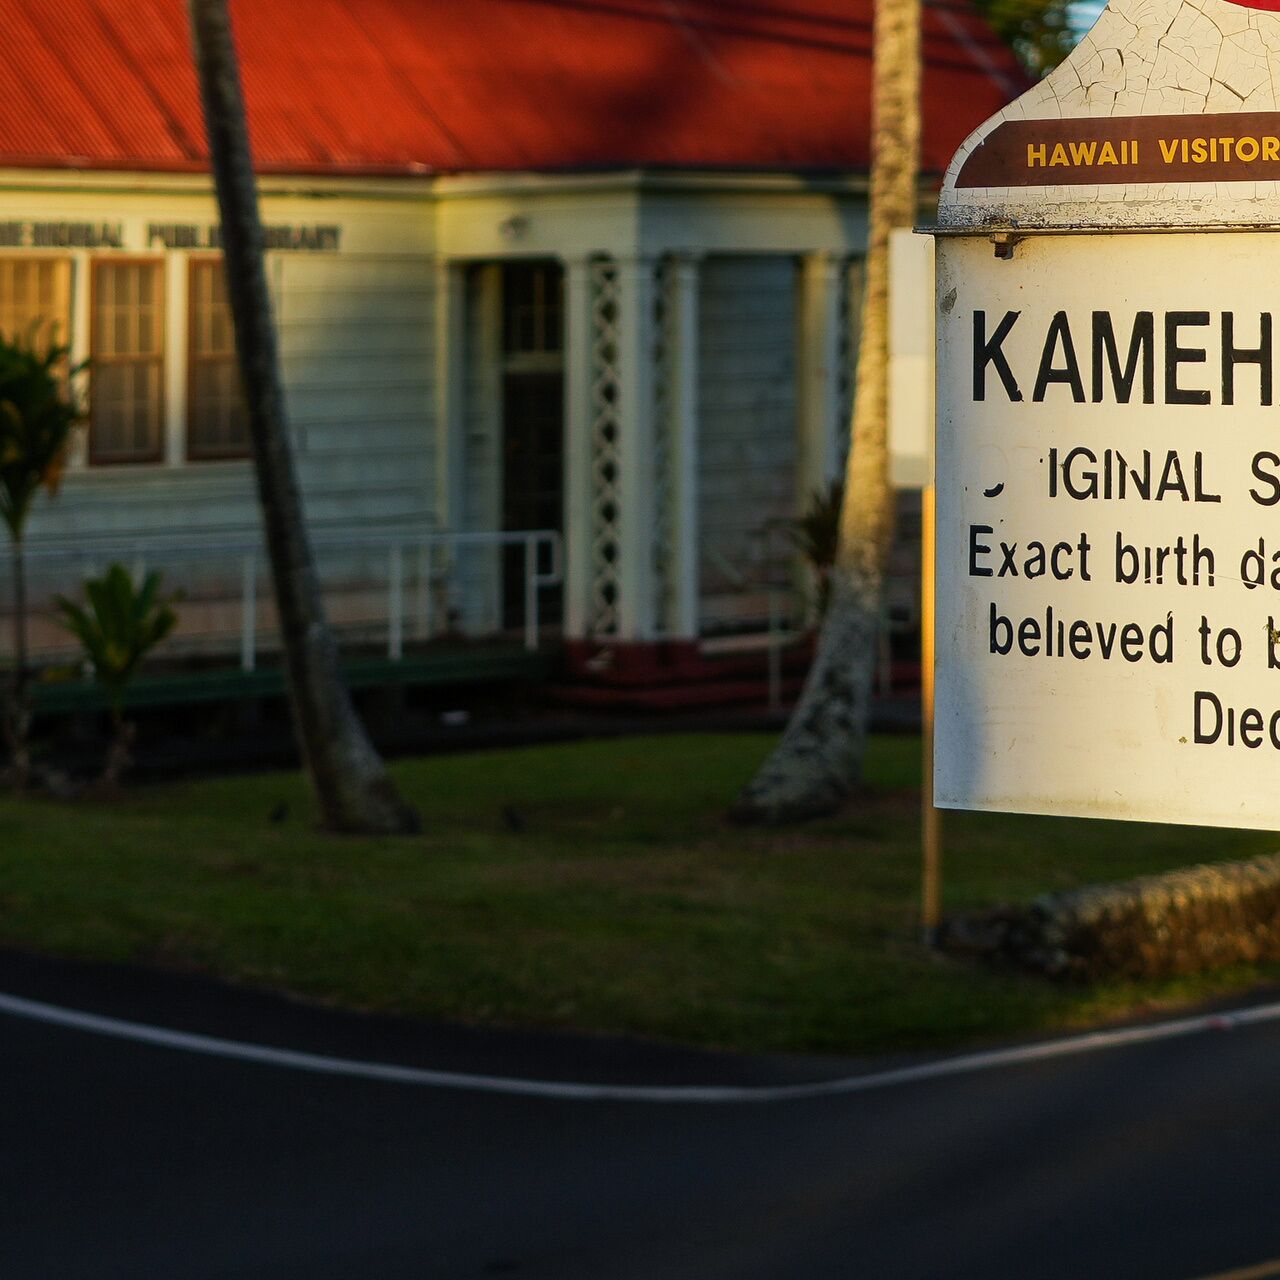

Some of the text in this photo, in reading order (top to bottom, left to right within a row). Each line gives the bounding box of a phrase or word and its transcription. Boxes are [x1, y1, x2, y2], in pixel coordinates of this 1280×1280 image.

[1027, 140, 1139, 168] HAWAII
[980, 445, 1223, 504] IGINAL
[968, 524, 1092, 583] Exact
[1115, 531, 1216, 588] birth
[989, 601, 1174, 665] believed
[1198, 615, 1243, 669] to
